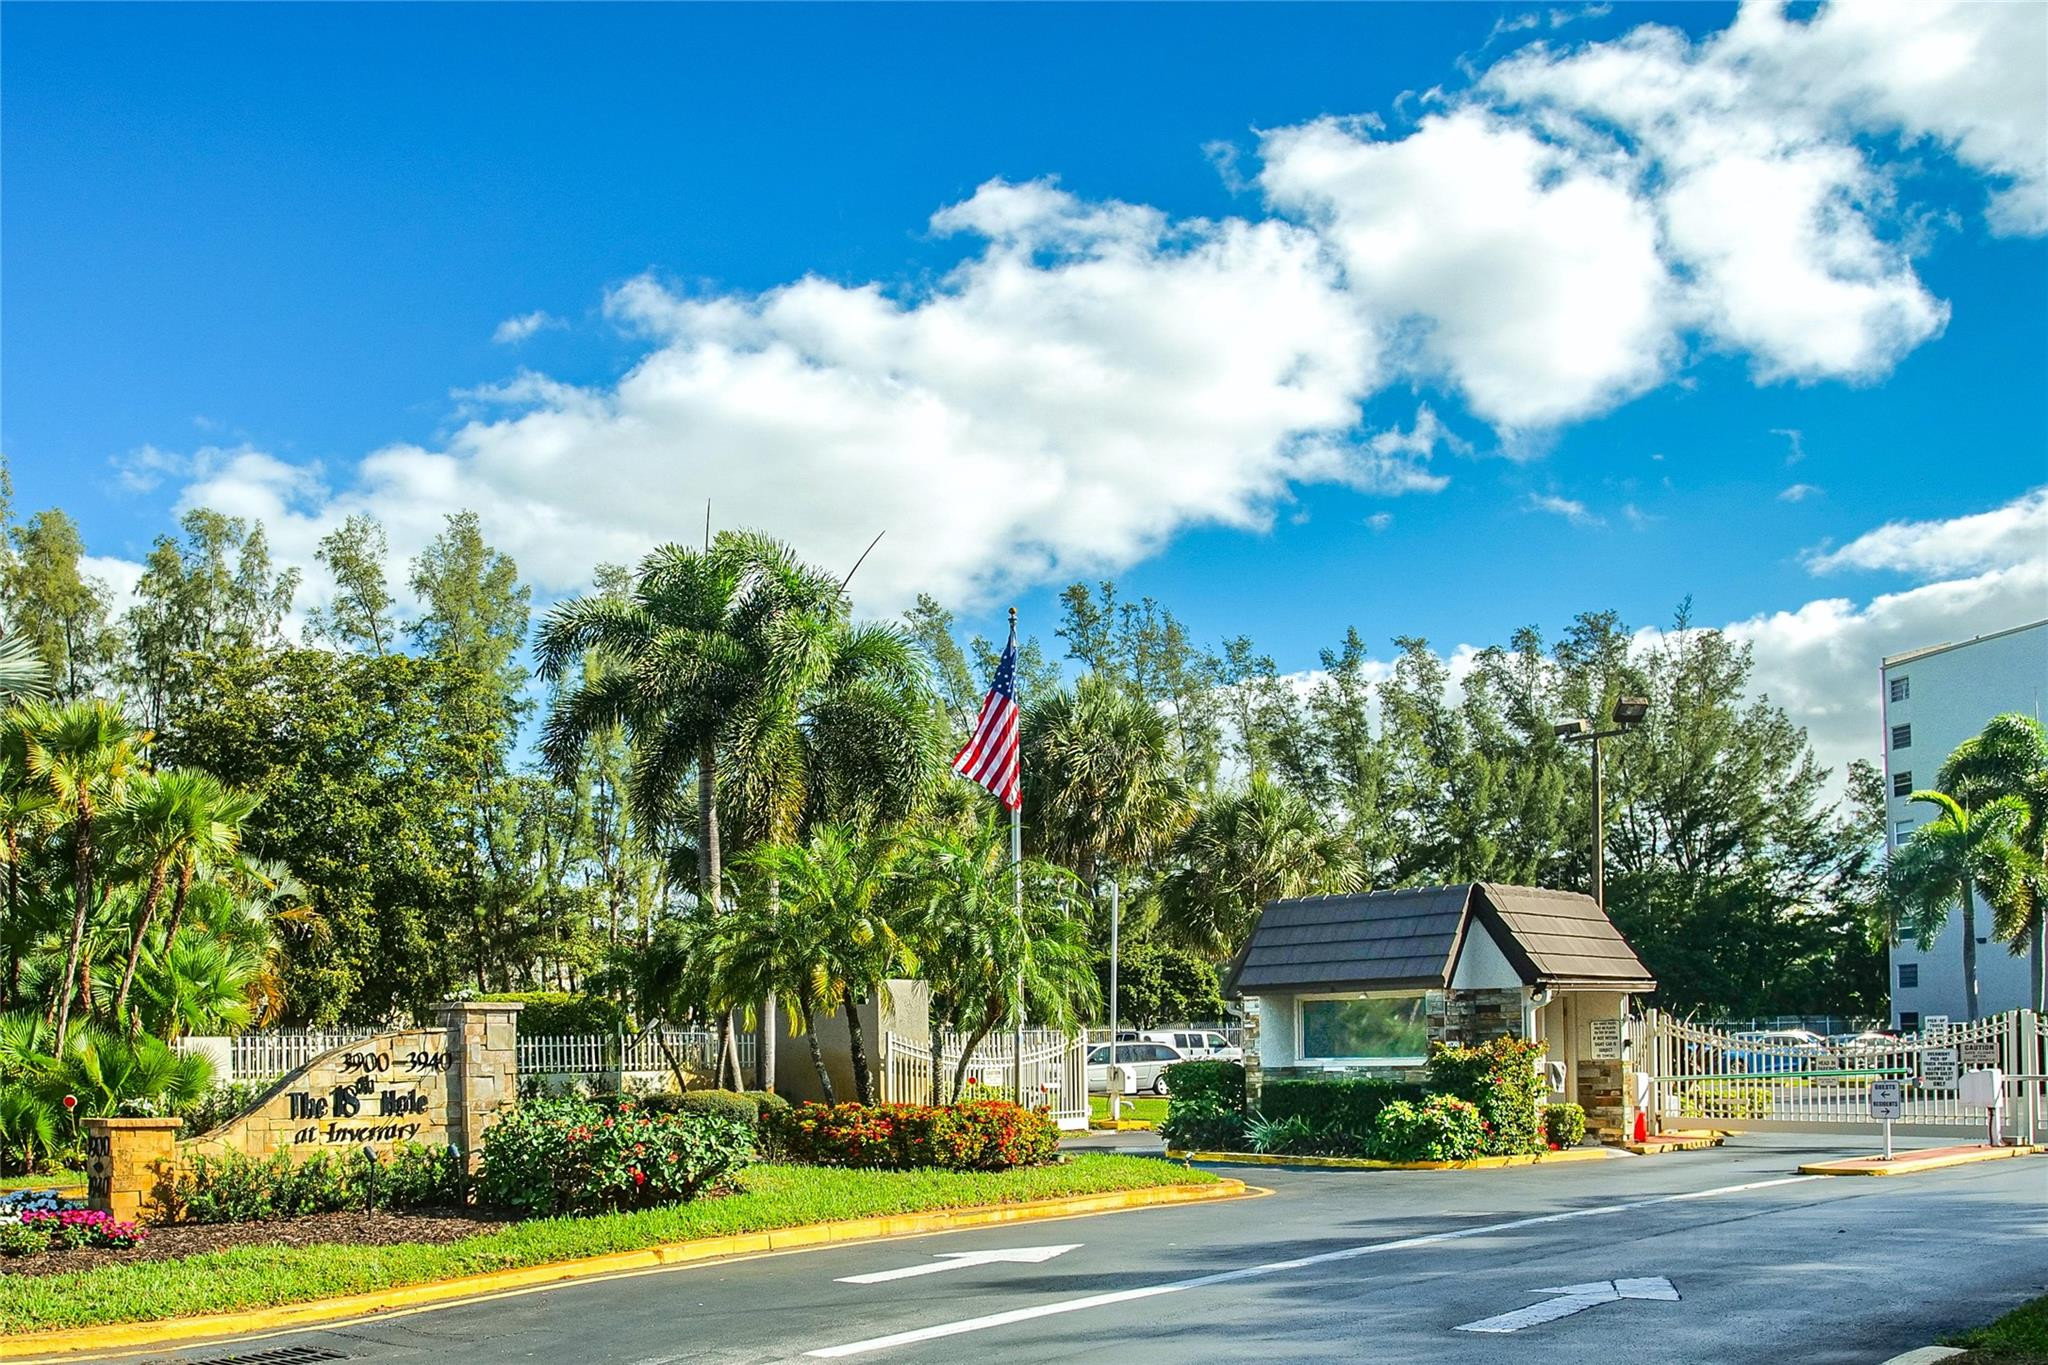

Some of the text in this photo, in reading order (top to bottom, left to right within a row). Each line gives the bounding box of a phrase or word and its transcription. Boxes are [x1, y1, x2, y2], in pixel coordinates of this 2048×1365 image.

[285, 1091, 329, 1120] The
[380, 1088, 429, 1117] Hole
[294, 1122, 421, 1144] at Inverrary
